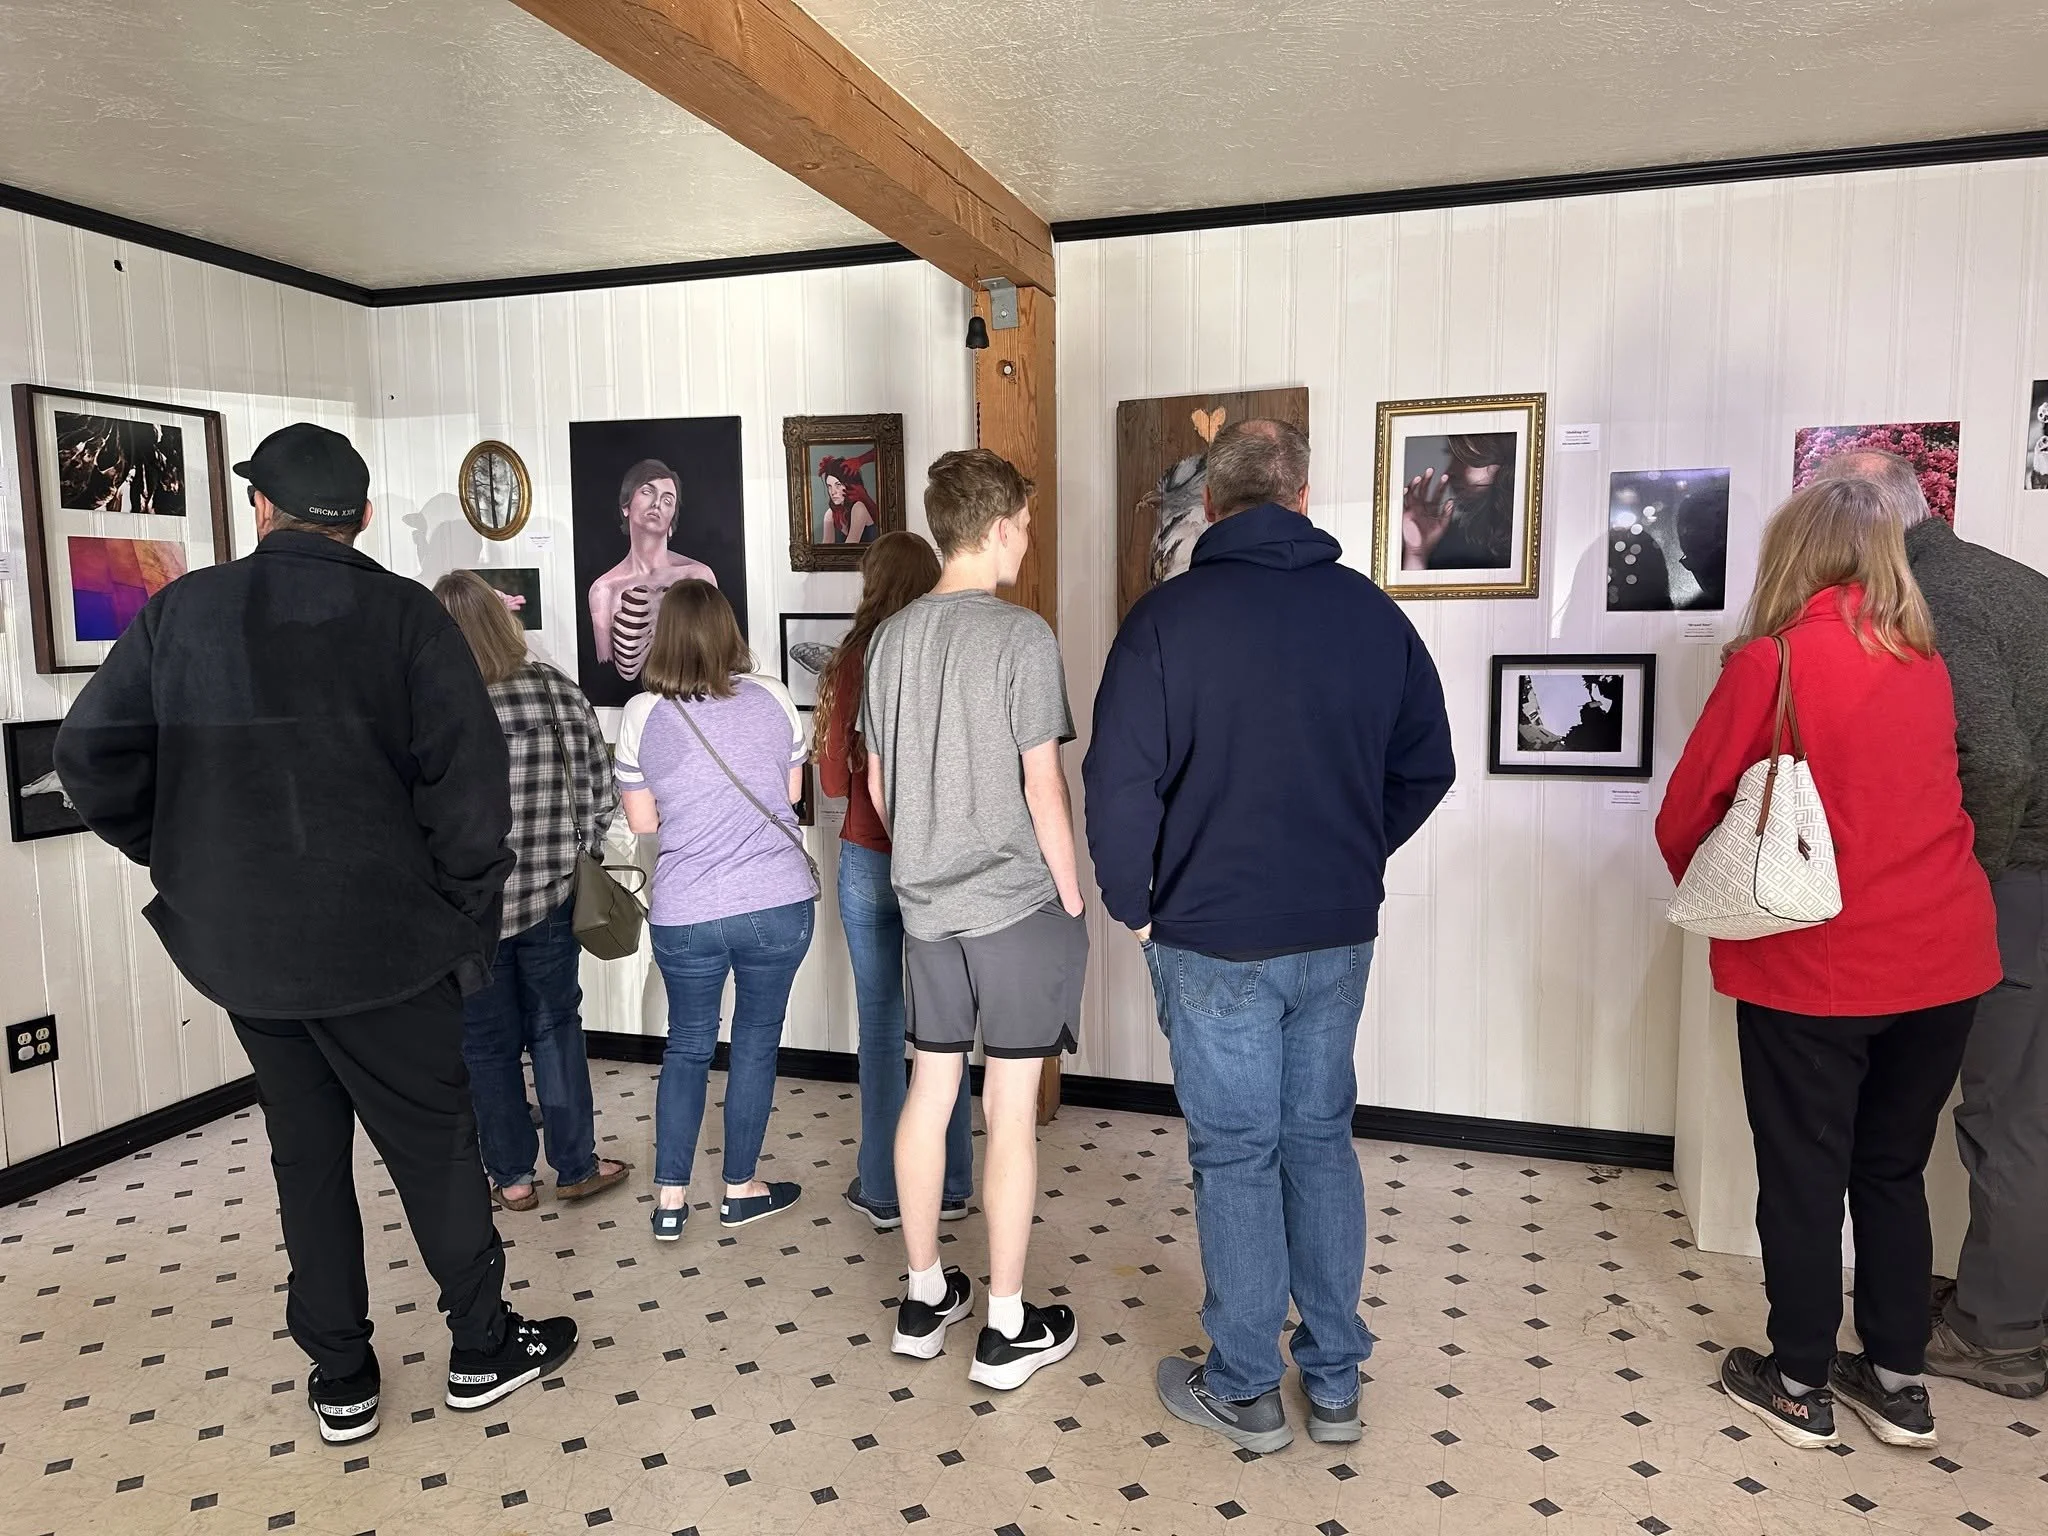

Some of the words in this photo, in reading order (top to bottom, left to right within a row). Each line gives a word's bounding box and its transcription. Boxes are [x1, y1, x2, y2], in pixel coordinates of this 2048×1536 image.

[308, 506, 339, 517] CIRCNA
[462, 1374, 495, 1383] KNIGHTS
[1772, 1394, 1809, 1420] HOKA
